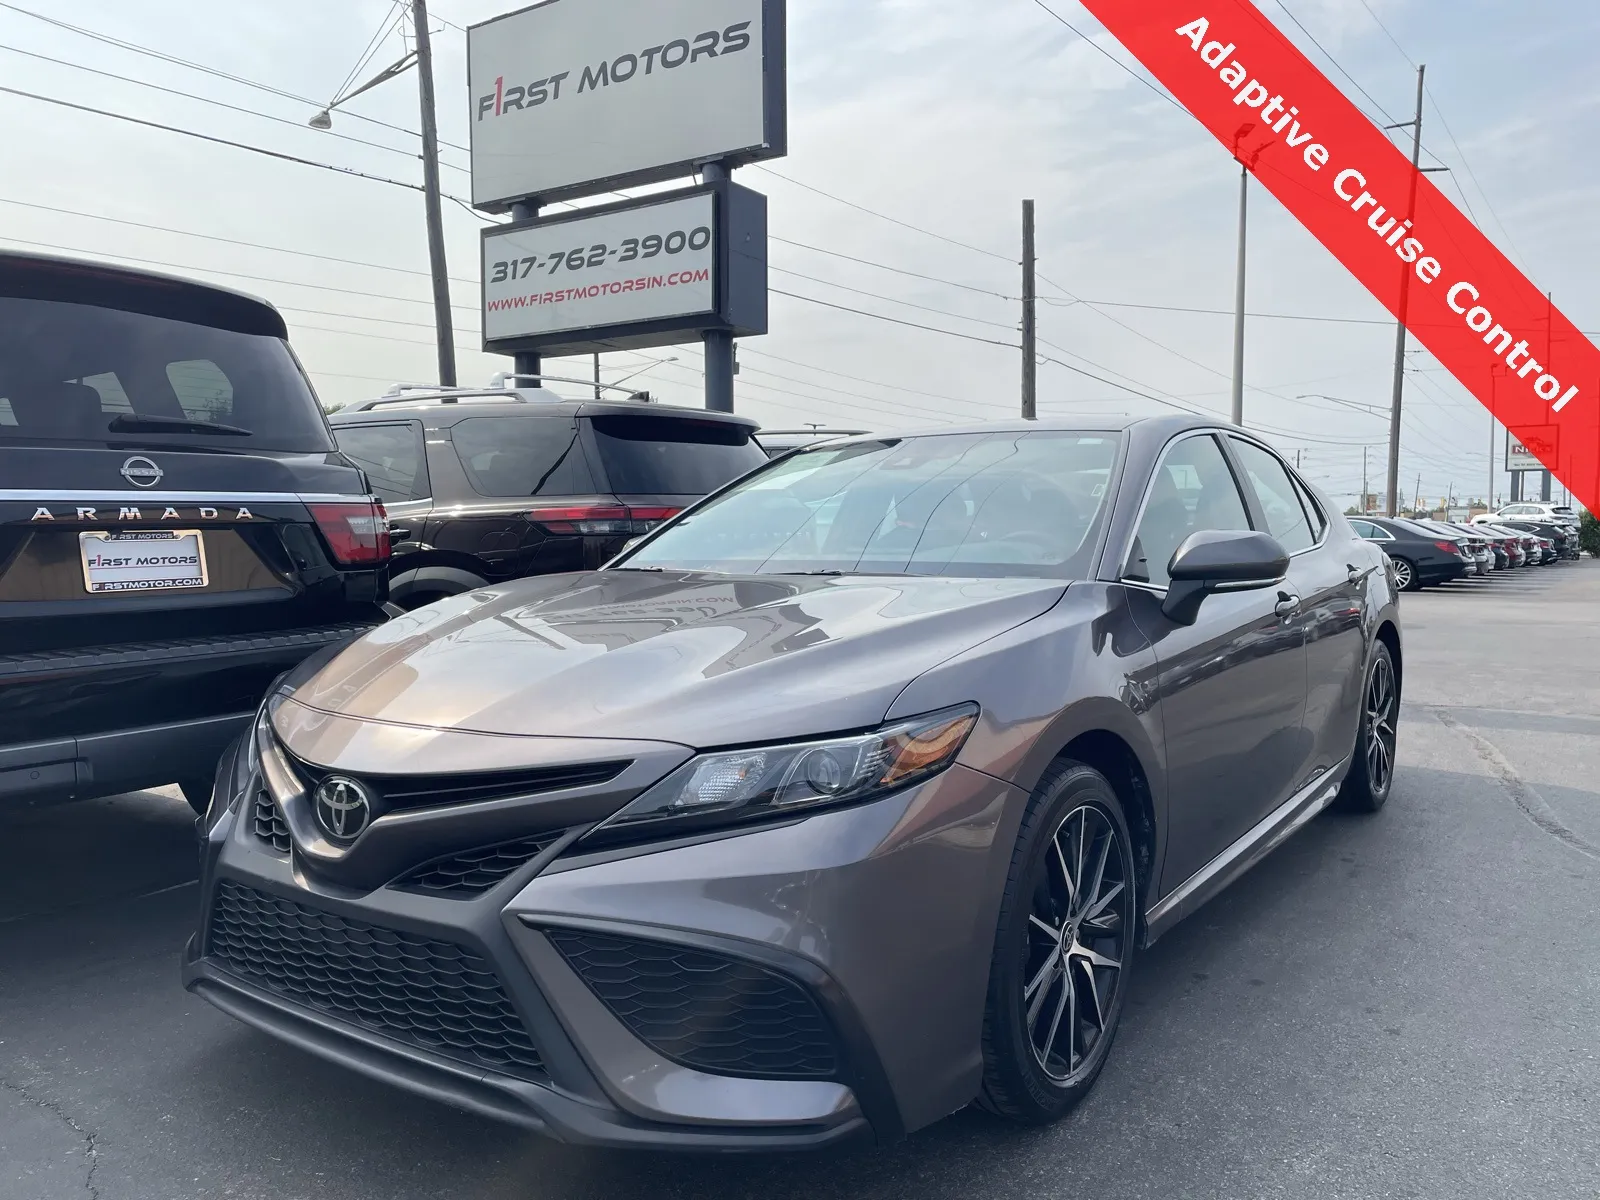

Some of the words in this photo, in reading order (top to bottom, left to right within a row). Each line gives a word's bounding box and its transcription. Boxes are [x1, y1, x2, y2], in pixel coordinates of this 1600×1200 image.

[577, 20, 752, 94] MOTORS
[490, 226, 711, 284] 317-762-3900
[487, 268, 710, 312] WWW.FIRSTMOTORSIN.COM
[120, 468, 163, 476] NISSAN
[31, 507, 254, 521] ARMADA
[135, 556, 198, 566] MOTORS
[92, 577, 203, 591] FRSTMOTOR.COM
